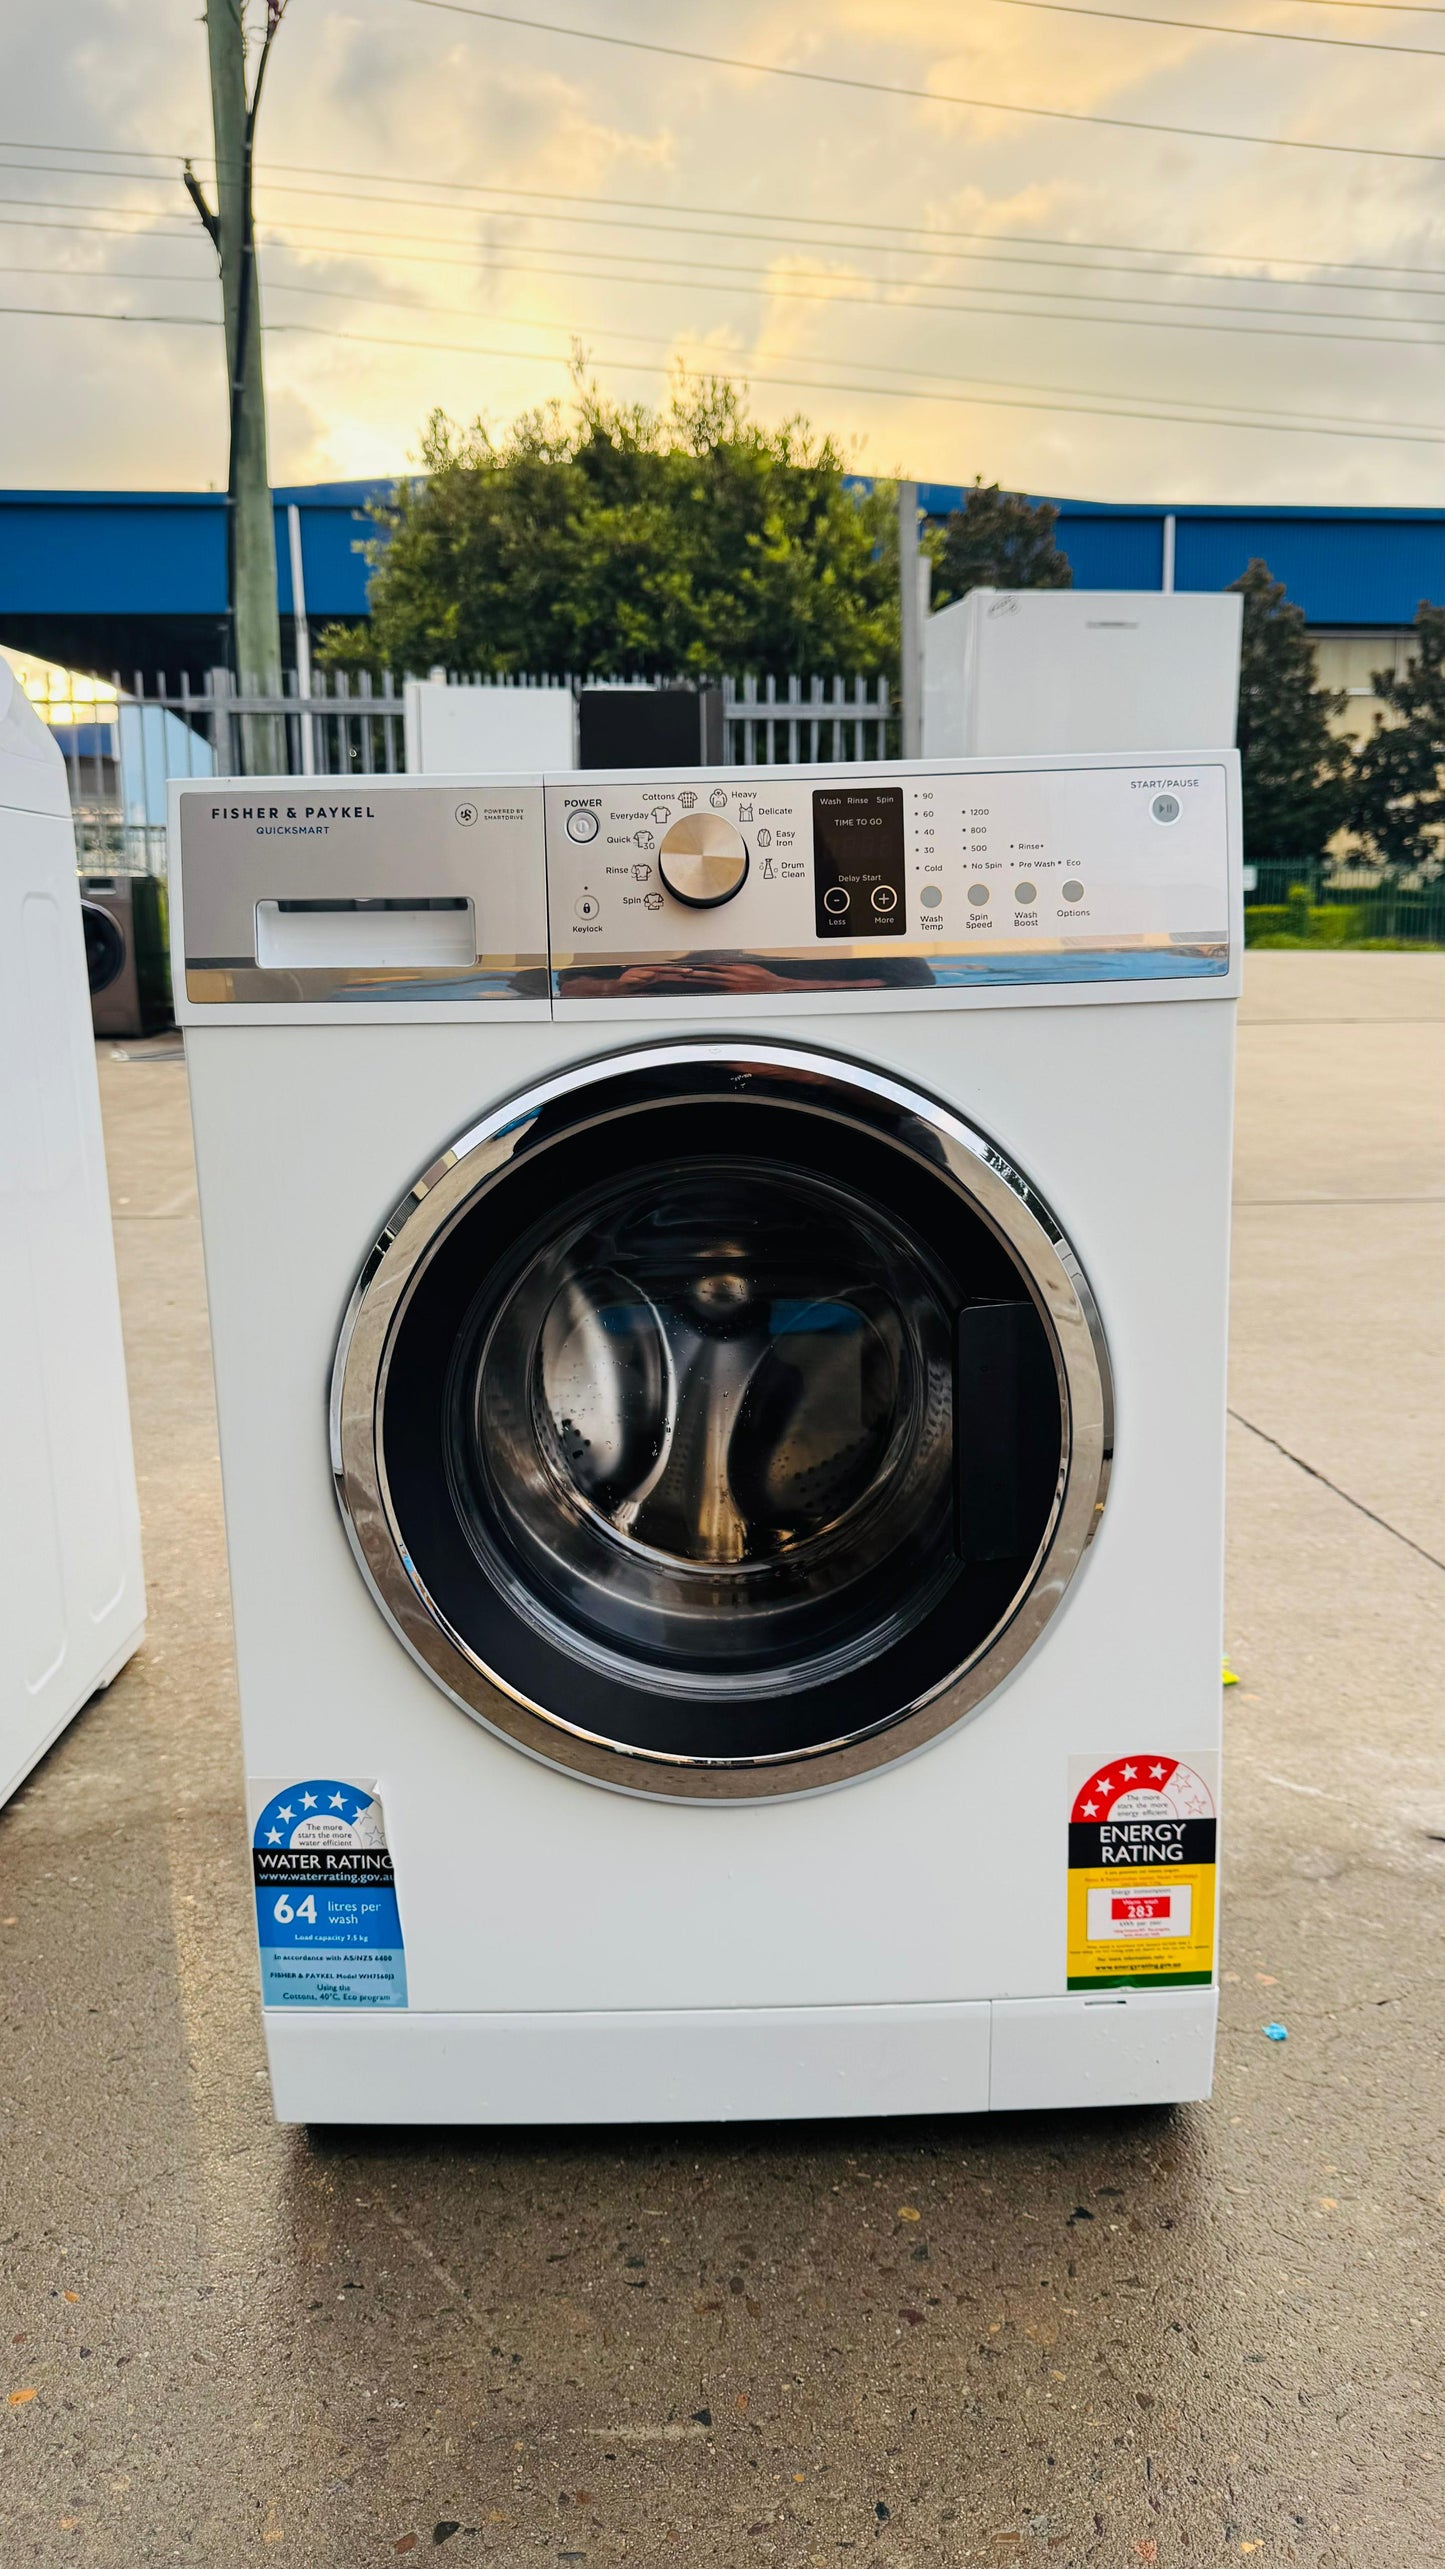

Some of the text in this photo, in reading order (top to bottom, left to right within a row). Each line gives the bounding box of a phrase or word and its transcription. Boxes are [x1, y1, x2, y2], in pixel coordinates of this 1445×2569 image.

[1130, 779, 1199, 789] START/PAUSE
[642, 793, 676, 801] Cottons
[731, 791, 758, 799] Heavy
[922, 792, 934, 800] 90
[564, 799, 603, 808] POWER
[876, 796, 894, 804] Spin
[211, 807, 375, 819] FISHER & PAYKEL
[758, 807, 793, 816] Delicate
[923, 810, 934, 818] 60
[970, 808, 990, 816] 1200
[610, 811, 649, 821] Everyday
[834, 818, 883, 827] TIME TO GO
[256, 826, 330, 835] QUICKSMART
[923, 828, 935, 836] 40
[970, 826, 987, 834] 800
[776, 830, 796, 839] Easy
[606, 836, 631, 844] Quick
[776, 839, 793, 847] Iron
[923, 846, 935, 854] 30
[970, 844, 987, 852] 500
[971, 861, 1003, 870] No Spin
[1033, 860, 1056, 868] Wash
[1065, 859, 1081, 867] Eco
[605, 866, 629, 874] Rinse
[924, 864, 943, 872] Cold
[781, 871, 806, 879] Clean
[838, 874, 882, 883] Delay Start
[622, 896, 642, 905] Spin
[969, 913, 989, 922] Spin
[1014, 911, 1038, 919] Wash
[1056, 909, 1091, 918] Options
[828, 918, 847, 926] Less
[874, 916, 895, 924] More
[919, 915, 944, 923] Wash
[1013, 919, 1039, 927] Boost
[920, 923, 944, 931] Temp
[965, 921, 993, 929] Speed
[572, 925, 603, 934] Keylock
[306, 1823, 322, 1831] The
[1099, 1823, 1187, 1843] ENERGY
[322, 1839, 352, 1847] efficient
[1101, 1843, 1184, 1864] RATING
[257, 1854, 394, 1870] WATER RATING
[273, 1893, 318, 1925] 64
[327, 1900, 382, 1915] litres per
[1127, 1905, 1154, 1918] 283
[328, 1914, 359, 1925] wash
[314, 1934, 345, 1942] capacity
[359, 1934, 369, 1943] kg
[316, 1984, 338, 1992] Using
[343, 1993, 358, 2001] Eco
[359, 1994, 391, 2003] program
